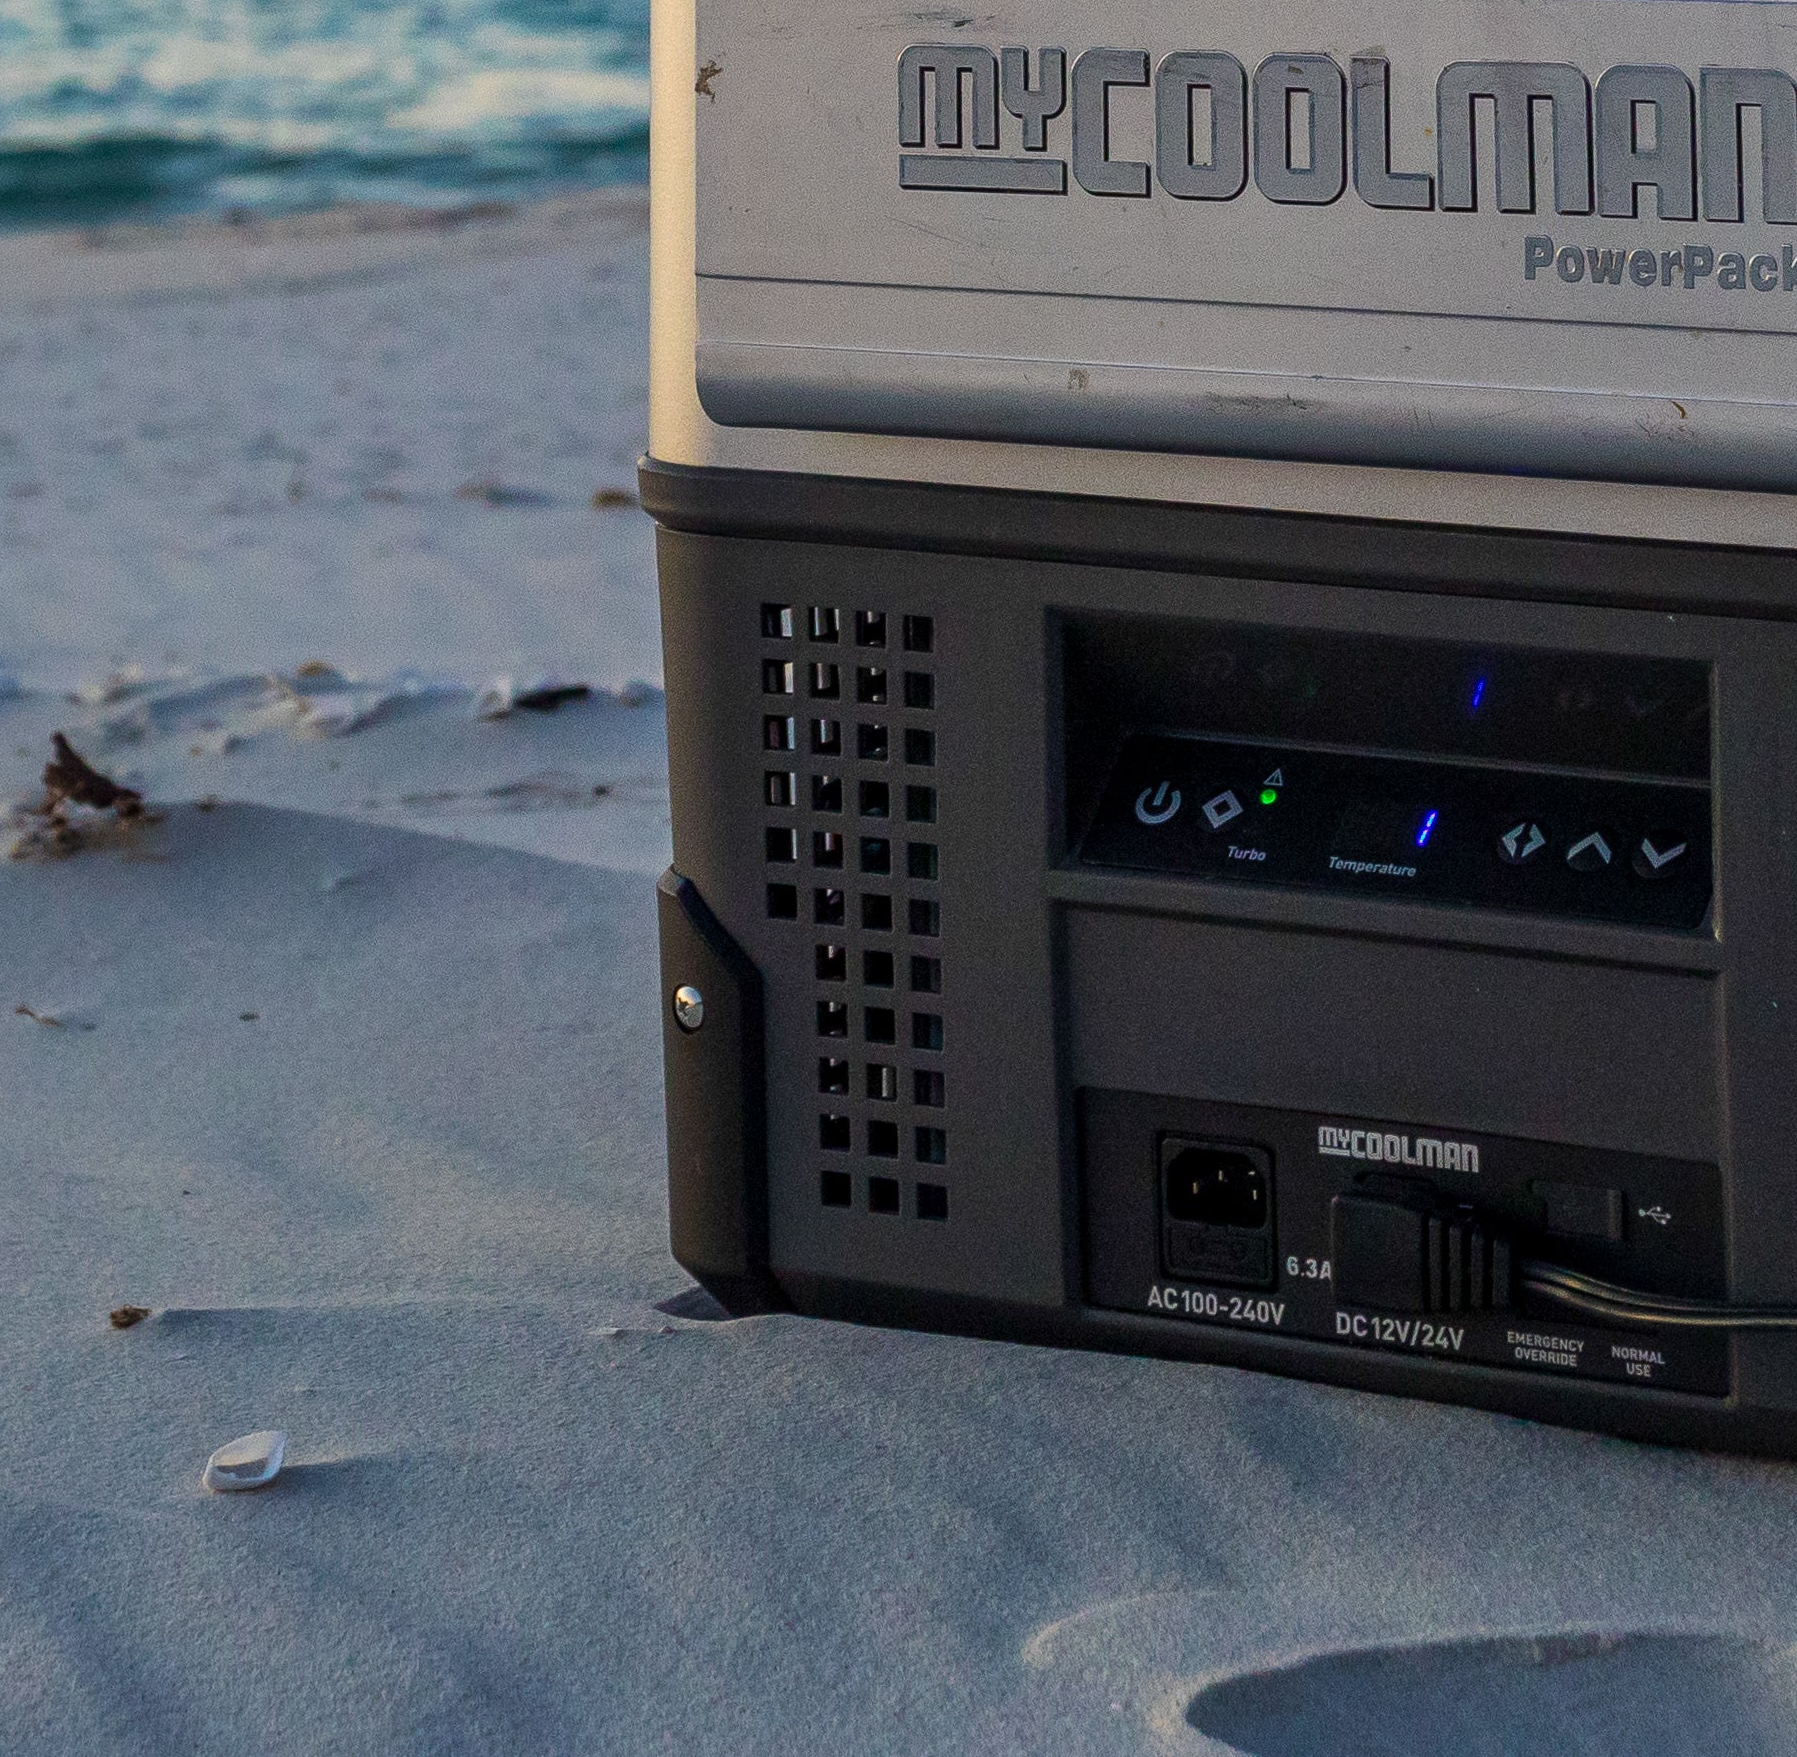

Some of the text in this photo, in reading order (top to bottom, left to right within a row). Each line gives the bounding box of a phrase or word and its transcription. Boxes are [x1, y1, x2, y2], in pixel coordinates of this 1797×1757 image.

[1227, 845, 1267, 862] Turbo
[1328, 855, 1417, 878] Temperature
[1317, 1126, 1480, 1174] MYCOOLMAN
[1286, 1255, 1333, 1281] 6.3A
[1506, 1330, 1585, 1353] EMERGENCY
[1514, 1346, 1578, 1368] OVERRIDE
[1611, 1345, 1666, 1365] NORMAL
[1626, 1362, 1652, 1378] USE
